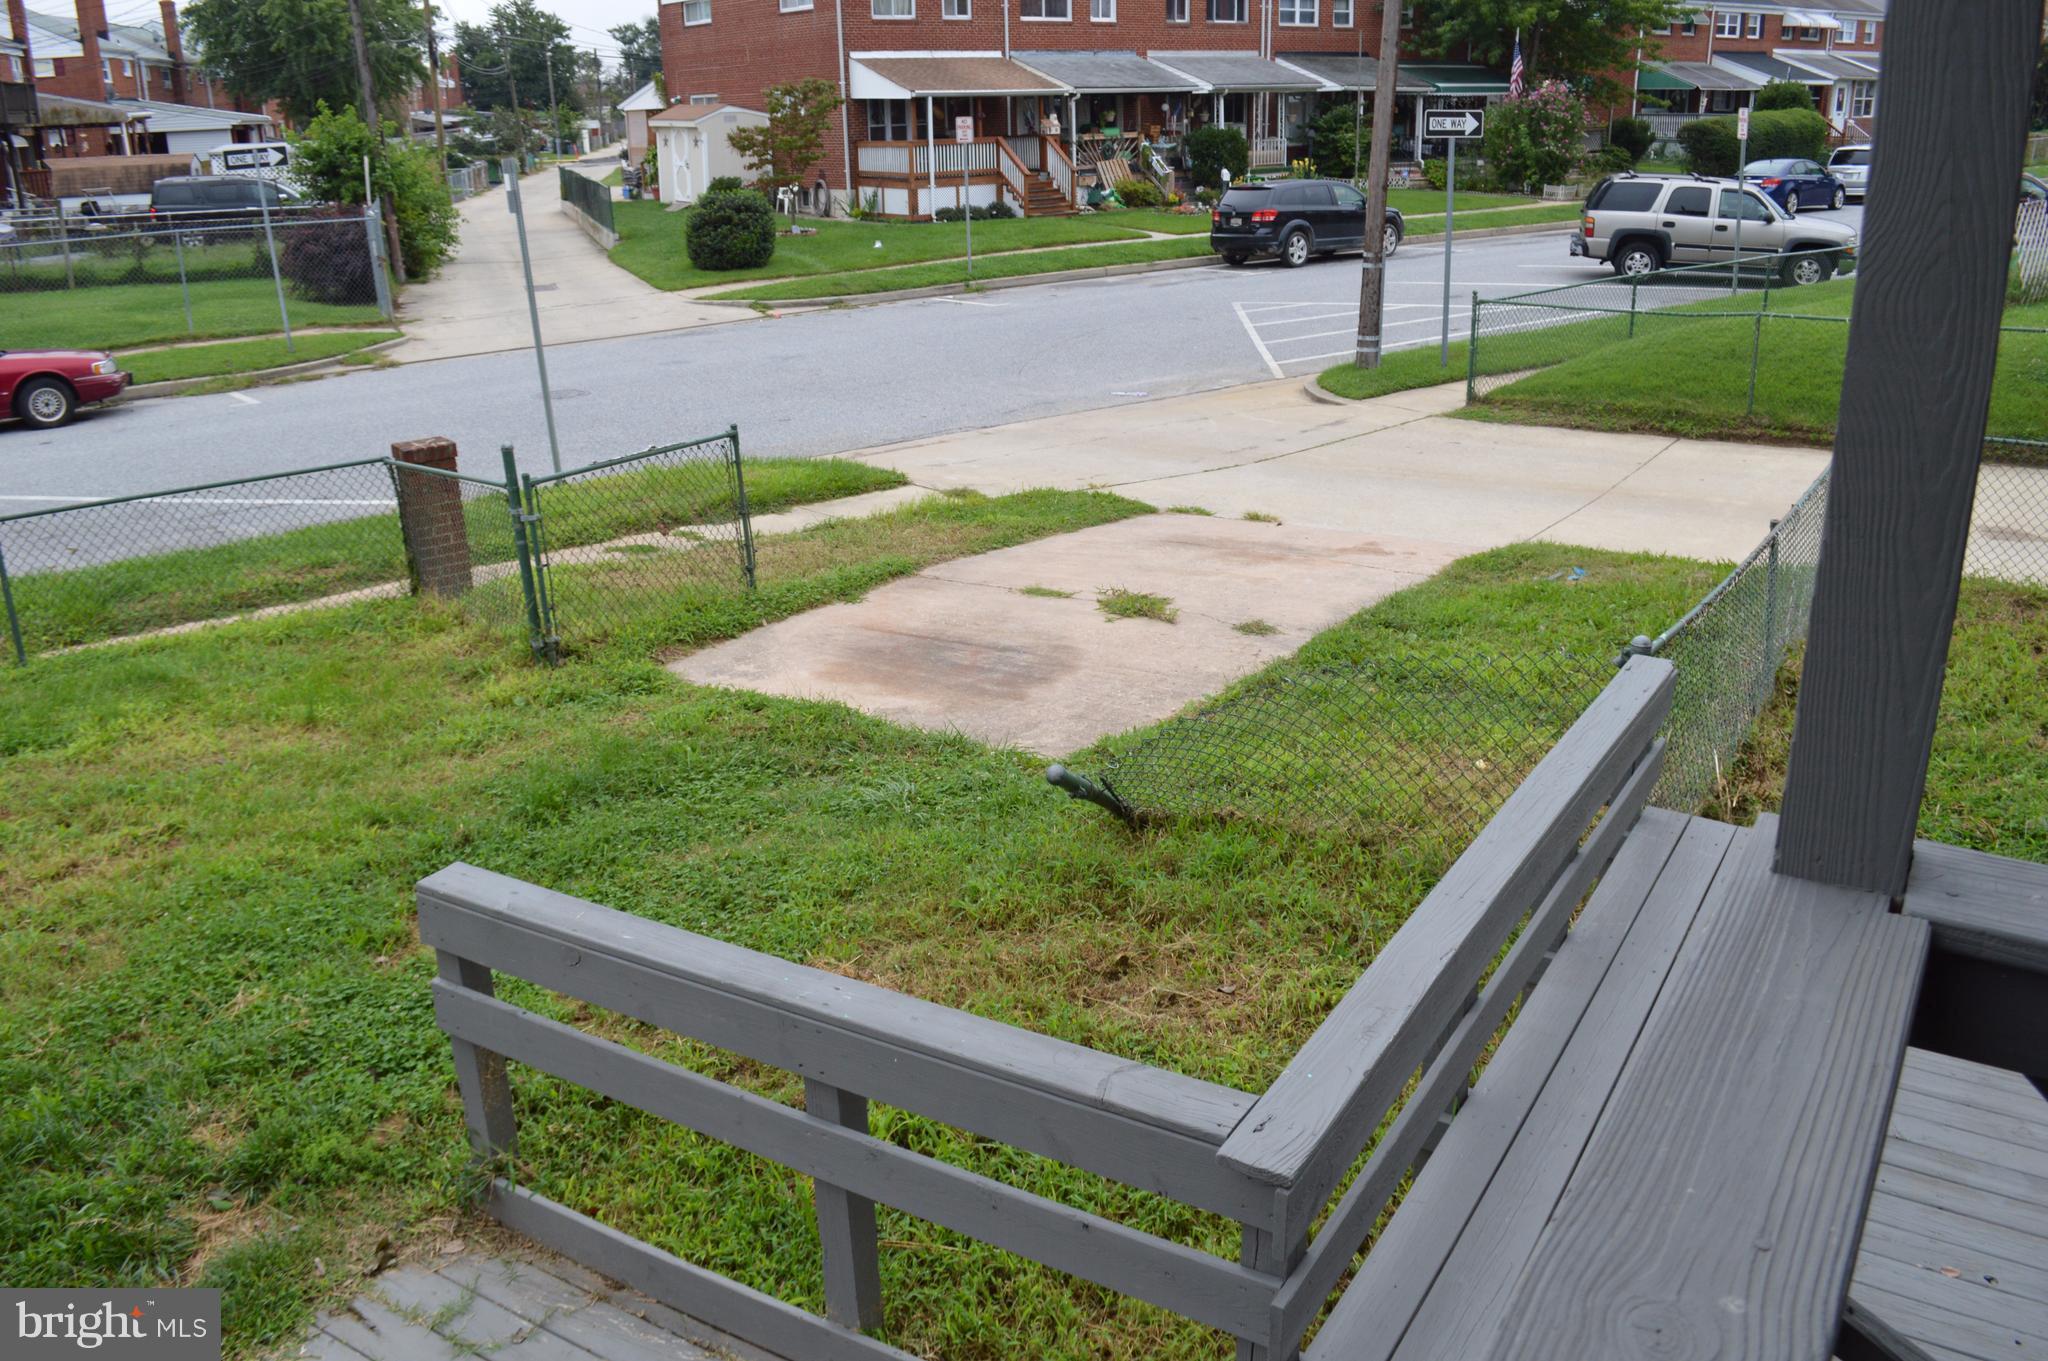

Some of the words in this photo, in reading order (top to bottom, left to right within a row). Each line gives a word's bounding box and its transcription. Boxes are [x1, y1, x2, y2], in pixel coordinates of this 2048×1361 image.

[1432, 118, 1447, 128] ONE
[1451, 118, 1466, 128] WAY
[230, 154, 248, 164] ONE
